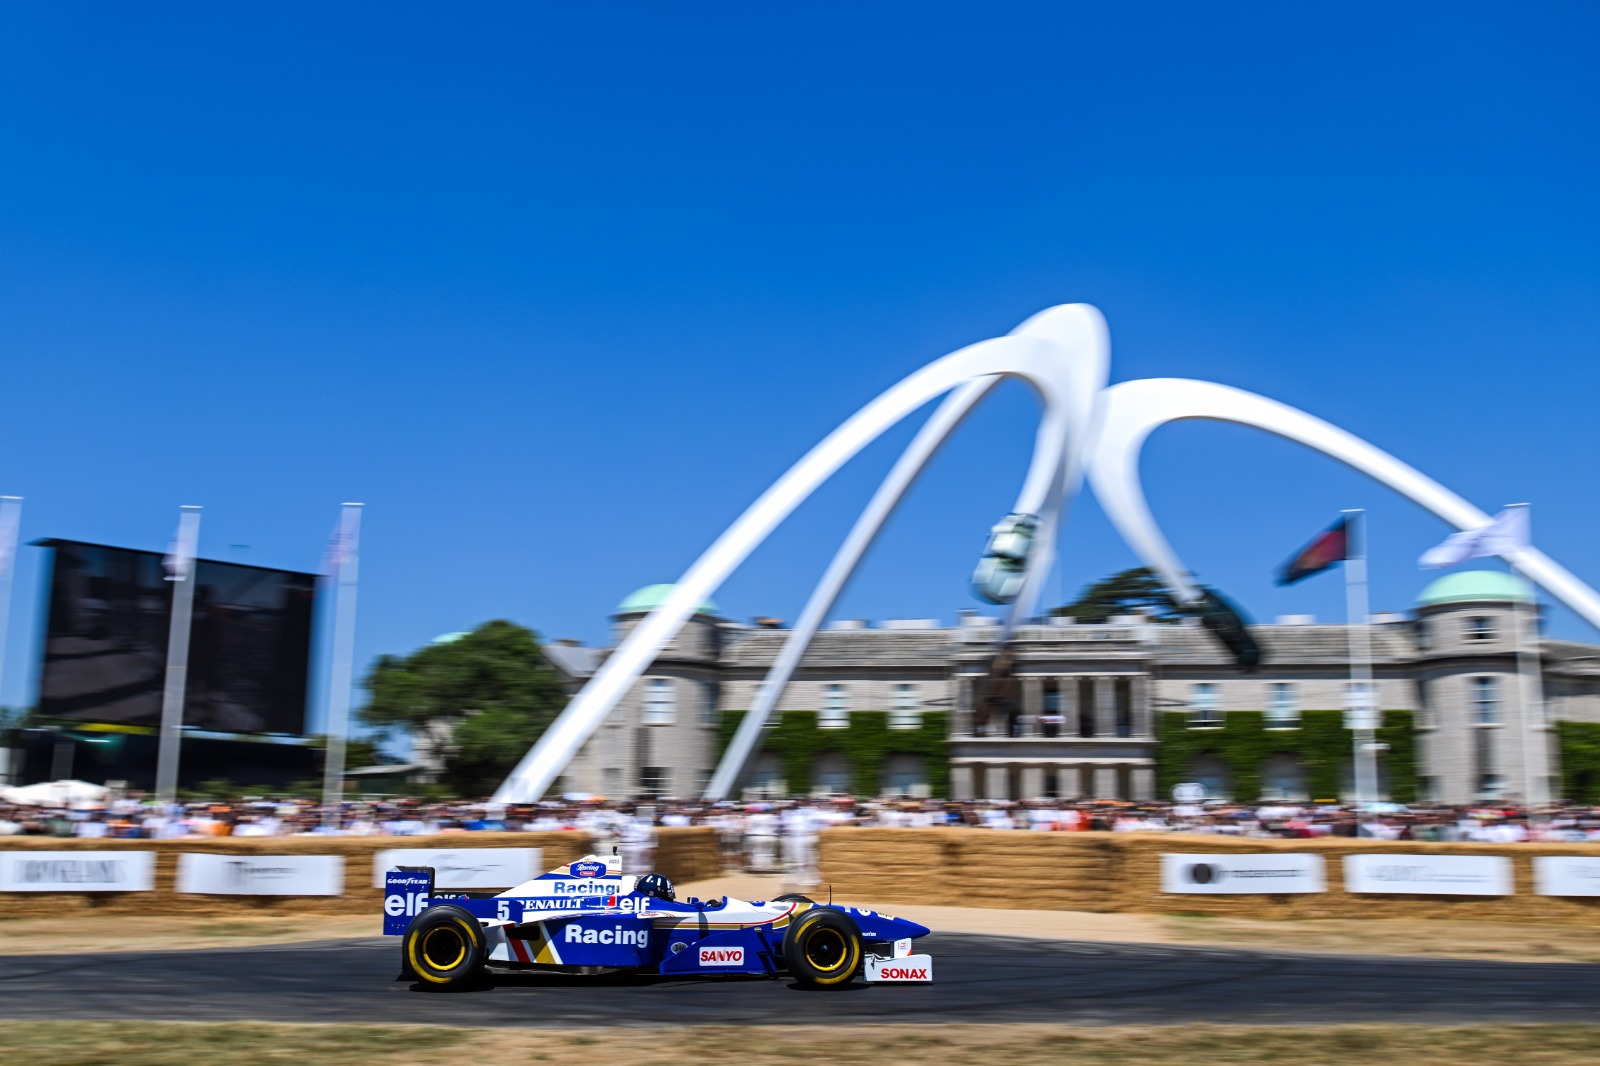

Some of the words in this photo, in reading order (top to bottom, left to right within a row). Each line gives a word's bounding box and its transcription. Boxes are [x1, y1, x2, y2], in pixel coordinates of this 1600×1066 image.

[387, 877, 428, 885] GOODYEAR
[553, 881, 615, 895] Racing
[384, 892, 429, 917] elf
[497, 900, 510, 921] 5
[619, 896, 650, 914] elf
[565, 924, 649, 949] Racing
[700, 950, 742, 962] SANYO
[881, 968, 927, 979] SONAX
